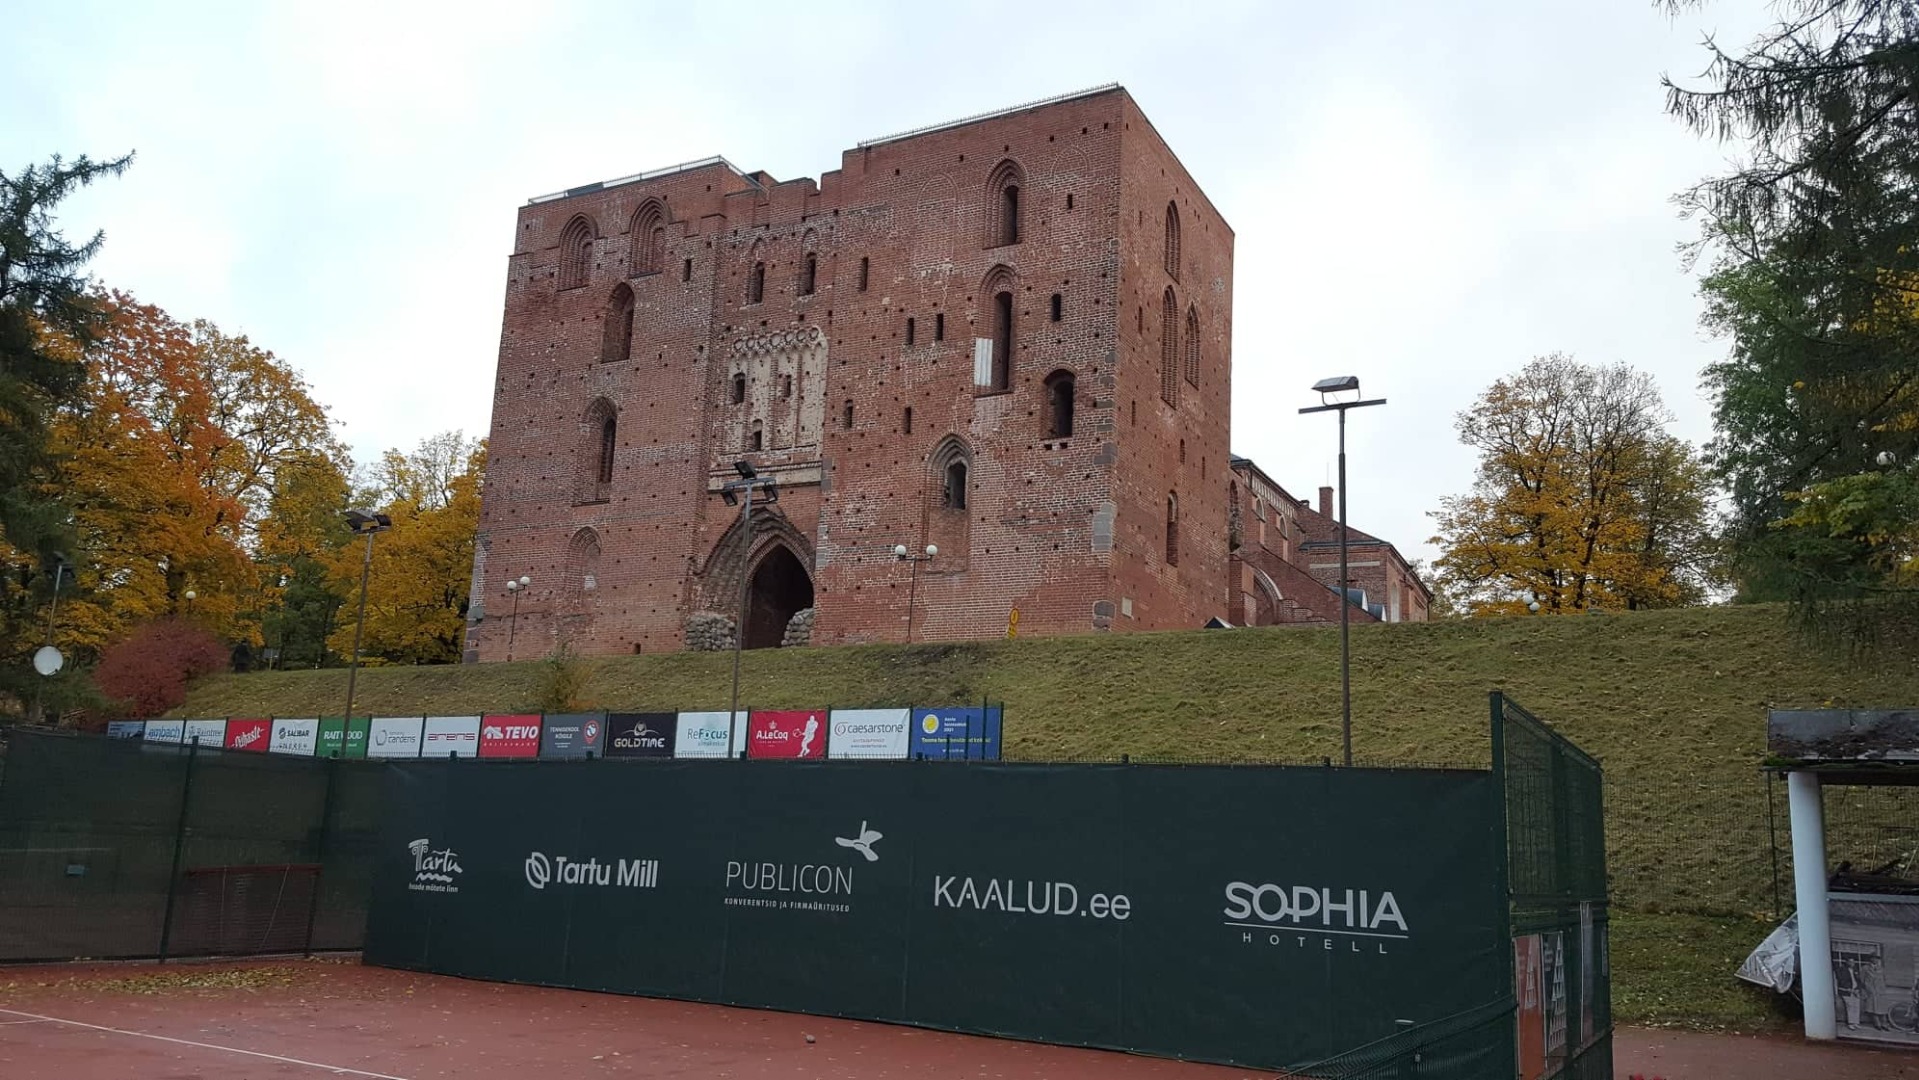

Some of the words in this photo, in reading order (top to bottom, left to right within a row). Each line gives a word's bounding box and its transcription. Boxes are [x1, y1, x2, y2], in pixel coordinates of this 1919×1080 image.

[505, 726, 539, 739] TEVO
[687, 728, 728, 741] ReFocus
[848, 723, 904, 734] caesarstone
[614, 737, 665, 748] GOLDTIME
[408, 838, 464, 874] Tartu
[555, 856, 612, 886] Tartu
[616, 858, 659, 888] Mill
[726, 861, 853, 895] PUBLICON
[446, 885, 459, 893] linn
[934, 875, 1131, 920] KAALUD.ee
[724, 897, 777, 908] KONVERENTSID
[779, 901, 788, 910] JA
[1223, 881, 1409, 931] SOPHIA
[1242, 932, 1388, 954] HOTELL
